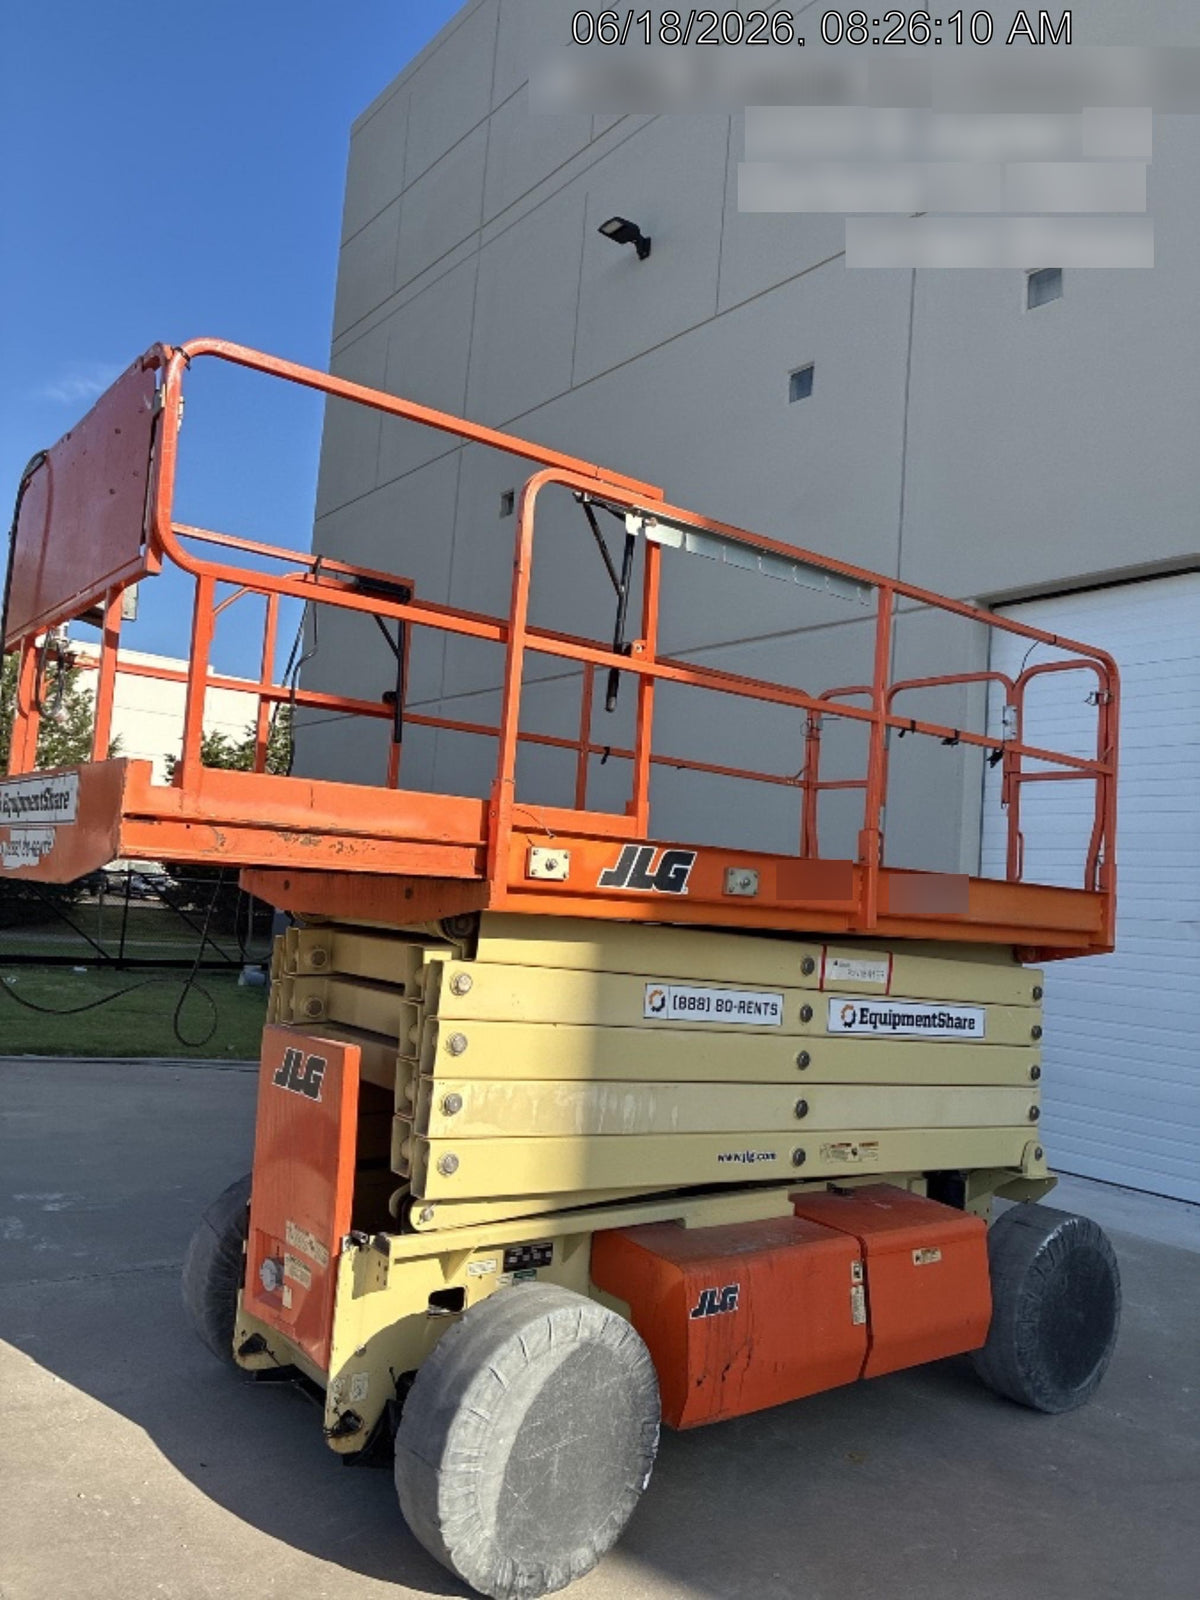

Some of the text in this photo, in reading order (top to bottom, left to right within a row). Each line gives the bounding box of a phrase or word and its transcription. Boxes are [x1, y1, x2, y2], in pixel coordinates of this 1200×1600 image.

[596, 844, 697, 894] JLG
[859, 1007, 975, 1030] EquipmentShare
[271, 1046, 328, 1103] JLG
[689, 1283, 740, 1319] JLG
